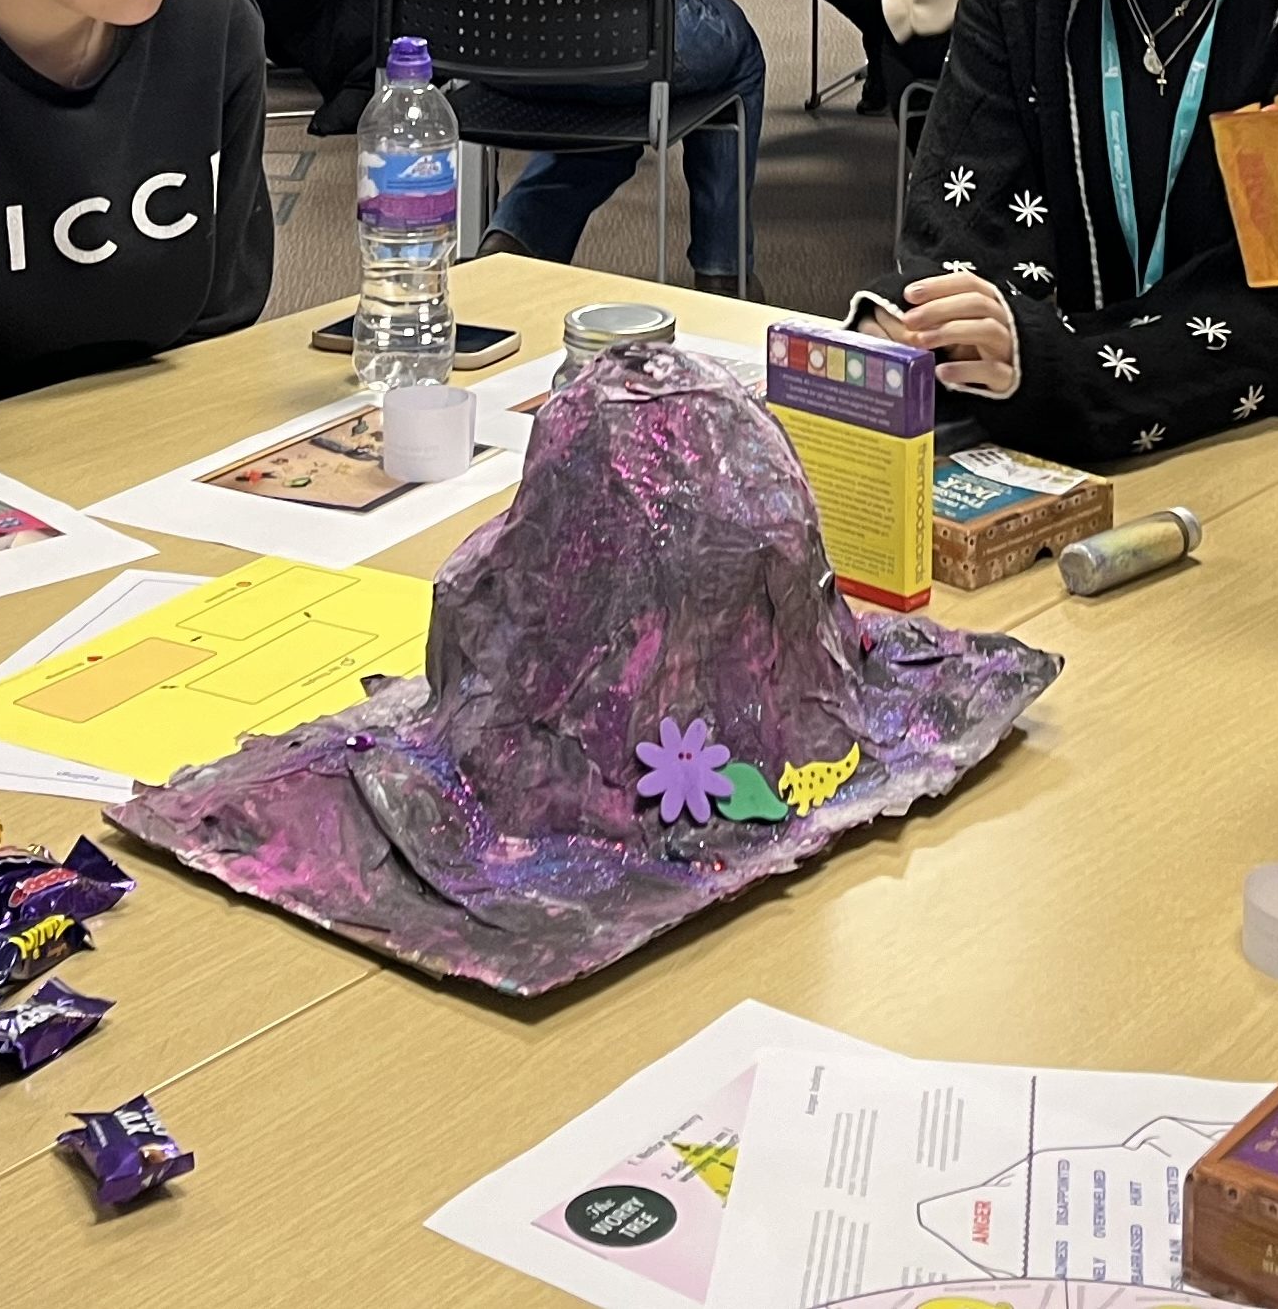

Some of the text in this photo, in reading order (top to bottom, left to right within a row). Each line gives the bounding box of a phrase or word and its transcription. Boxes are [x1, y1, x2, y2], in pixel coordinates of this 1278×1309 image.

[590, 1195, 645, 1235] WORRY
[618, 1210, 659, 1238] TREE
[971, 1200, 992, 1246] ANGER
[1092, 1169, 1107, 1282] NELY OVERWHELMED
[1055, 1240, 1069, 1281] ADNESS
[1129, 1223, 1145, 1285] BARRASSED
